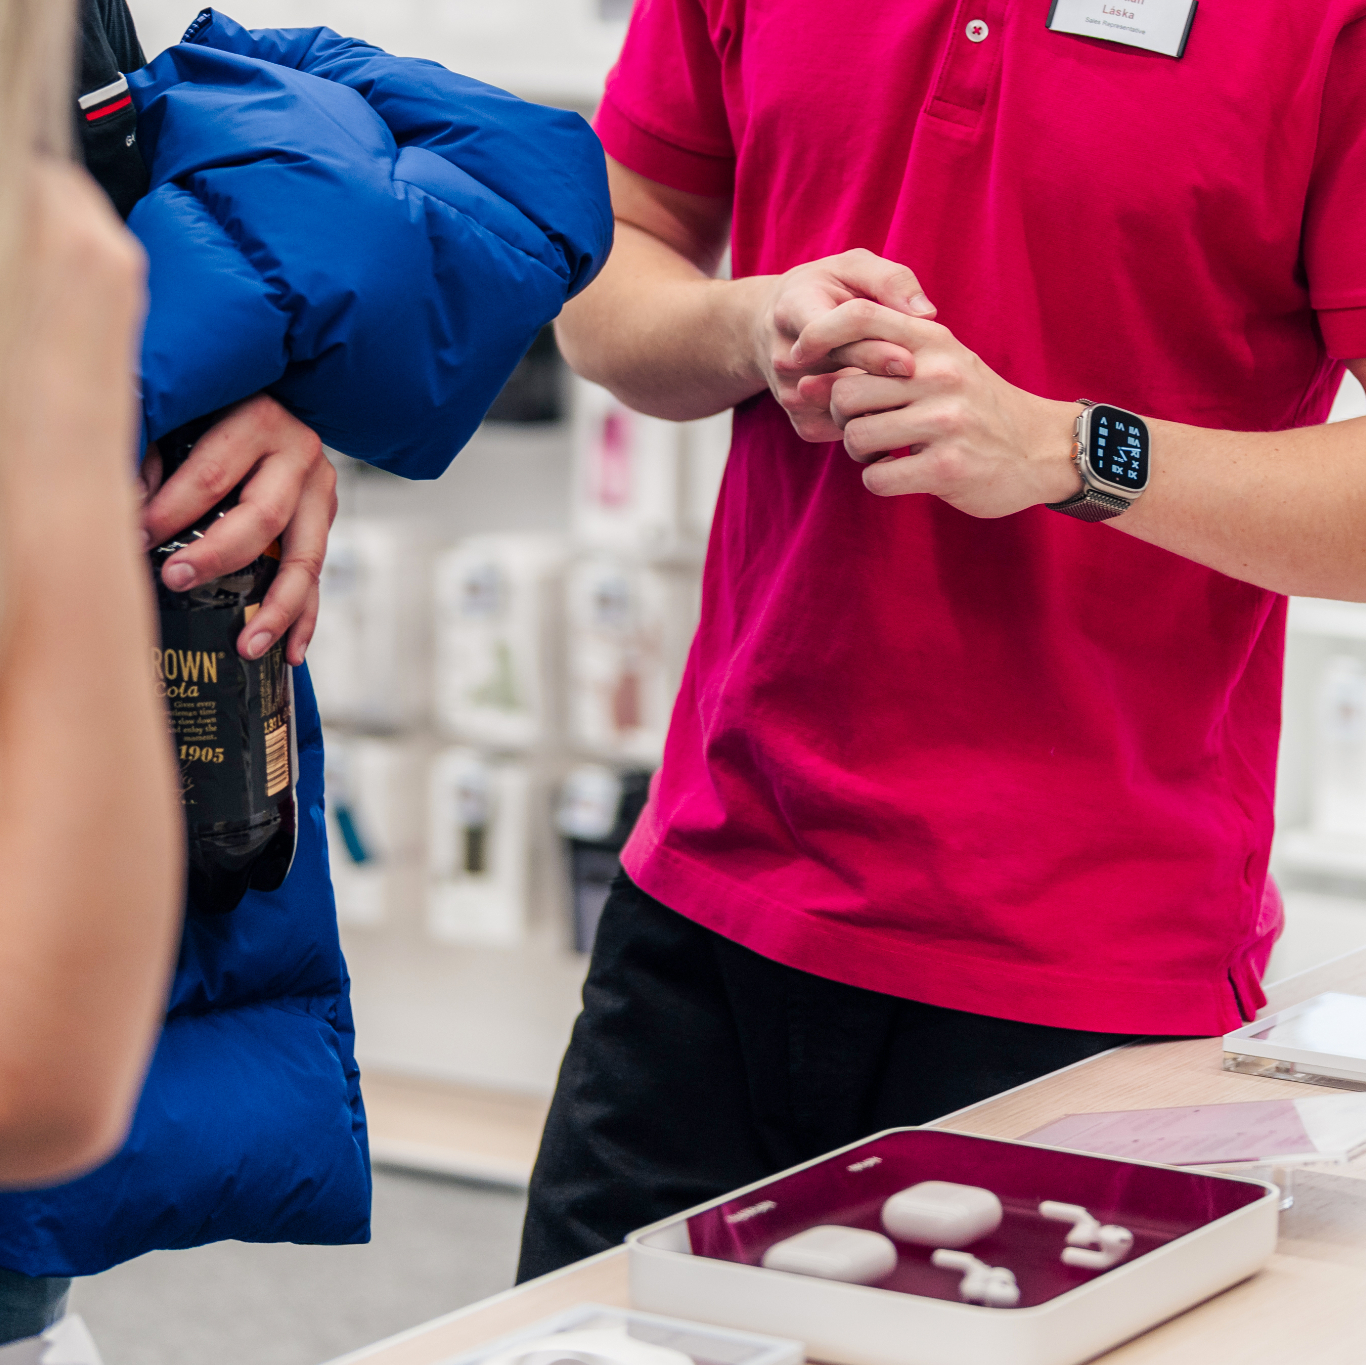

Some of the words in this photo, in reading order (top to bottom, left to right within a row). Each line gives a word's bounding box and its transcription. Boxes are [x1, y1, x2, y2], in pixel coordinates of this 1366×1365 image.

[1102, 4, 1135, 20] Láska
[1085, 16, 1101, 25] Sales
[1102, 20, 1146, 34] Representative
[179, 744, 225, 764] 1905
